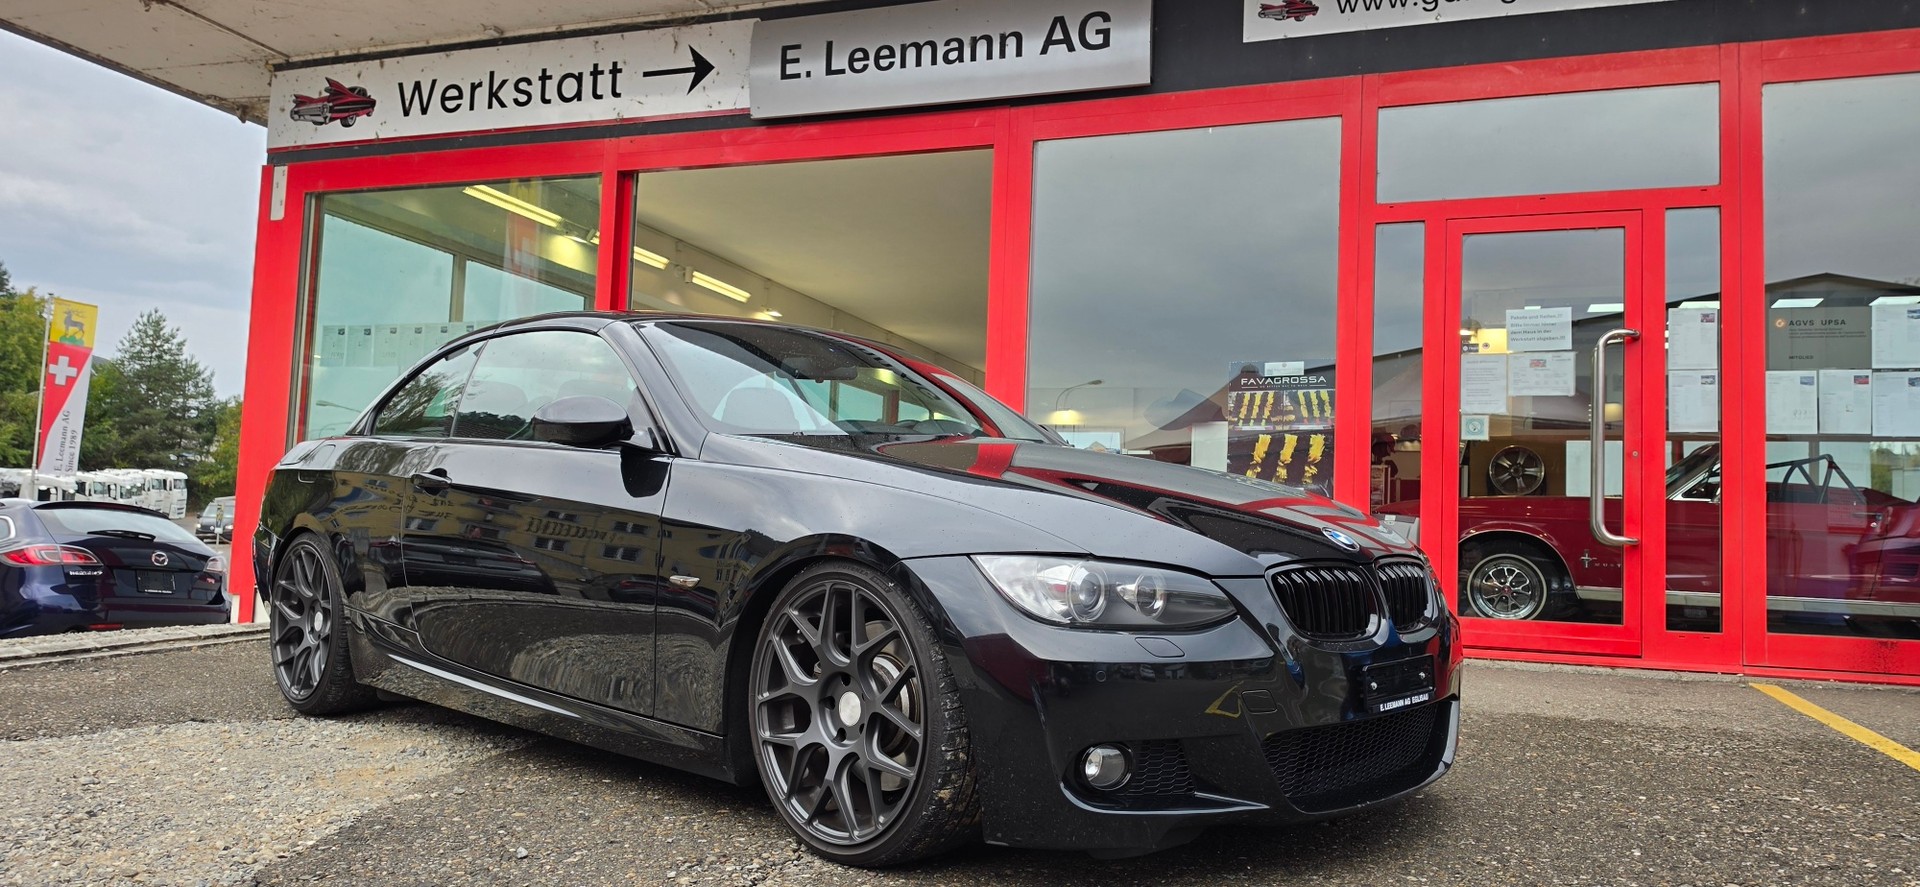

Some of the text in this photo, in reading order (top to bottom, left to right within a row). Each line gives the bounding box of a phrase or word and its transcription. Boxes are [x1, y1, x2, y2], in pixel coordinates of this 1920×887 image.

[780, 10, 1112, 81] E. Leemann AG
[397, 61, 623, 118] Werkstatt
[1788, 318, 1847, 327] AGVS UPSA
[1241, 376, 1327, 385] FAVAGROSSA
[61, 410, 71, 424] AG
[55, 426, 68, 461] Leemann
[65, 429, 78, 473] Since 1989
[1380, 703, 1385, 712] E.
[1384, 699, 1405, 710] LEEMANN
[1404, 697, 1411, 705] AG
